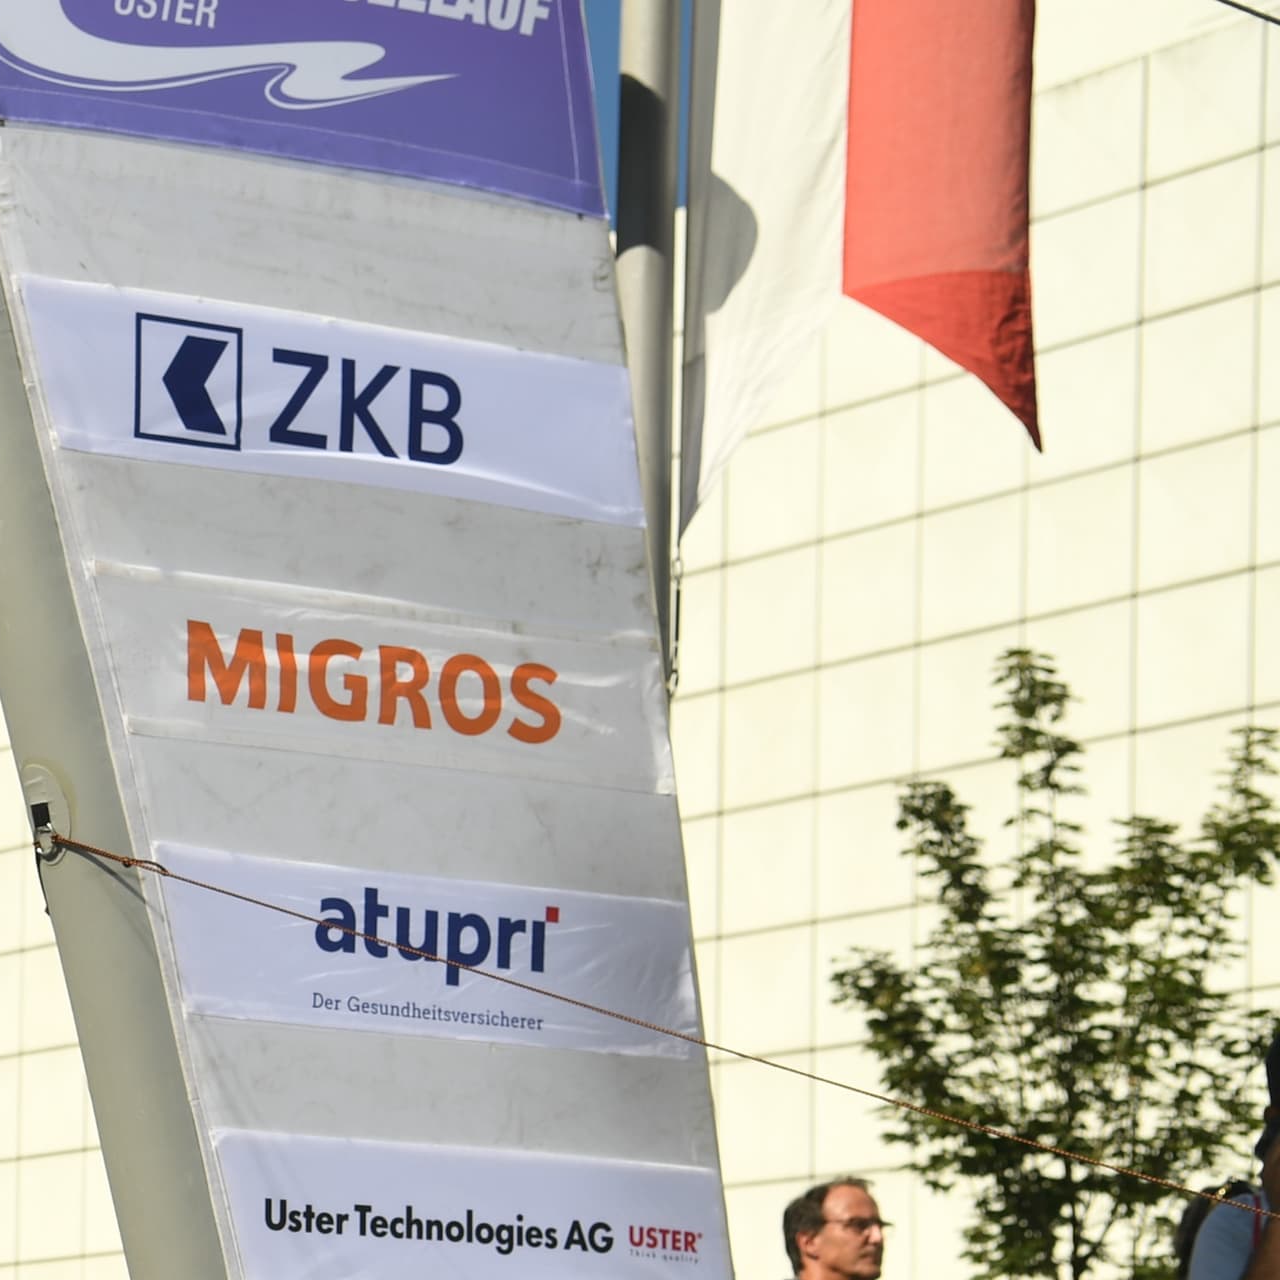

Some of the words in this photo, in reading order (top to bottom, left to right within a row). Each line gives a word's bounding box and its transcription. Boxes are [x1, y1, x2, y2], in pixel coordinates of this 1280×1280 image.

[269, 347, 464, 465] ZKB
[186, 619, 562, 744] MIGROS
[315, 887, 559, 986] atupri
[312, 992, 341, 1011] Der
[347, 996, 544, 1030] Gesundheitsversicherer
[264, 1198, 348, 1235] Uster
[354, 1204, 558, 1255] Technologies
[564, 1220, 614, 1254] AG
